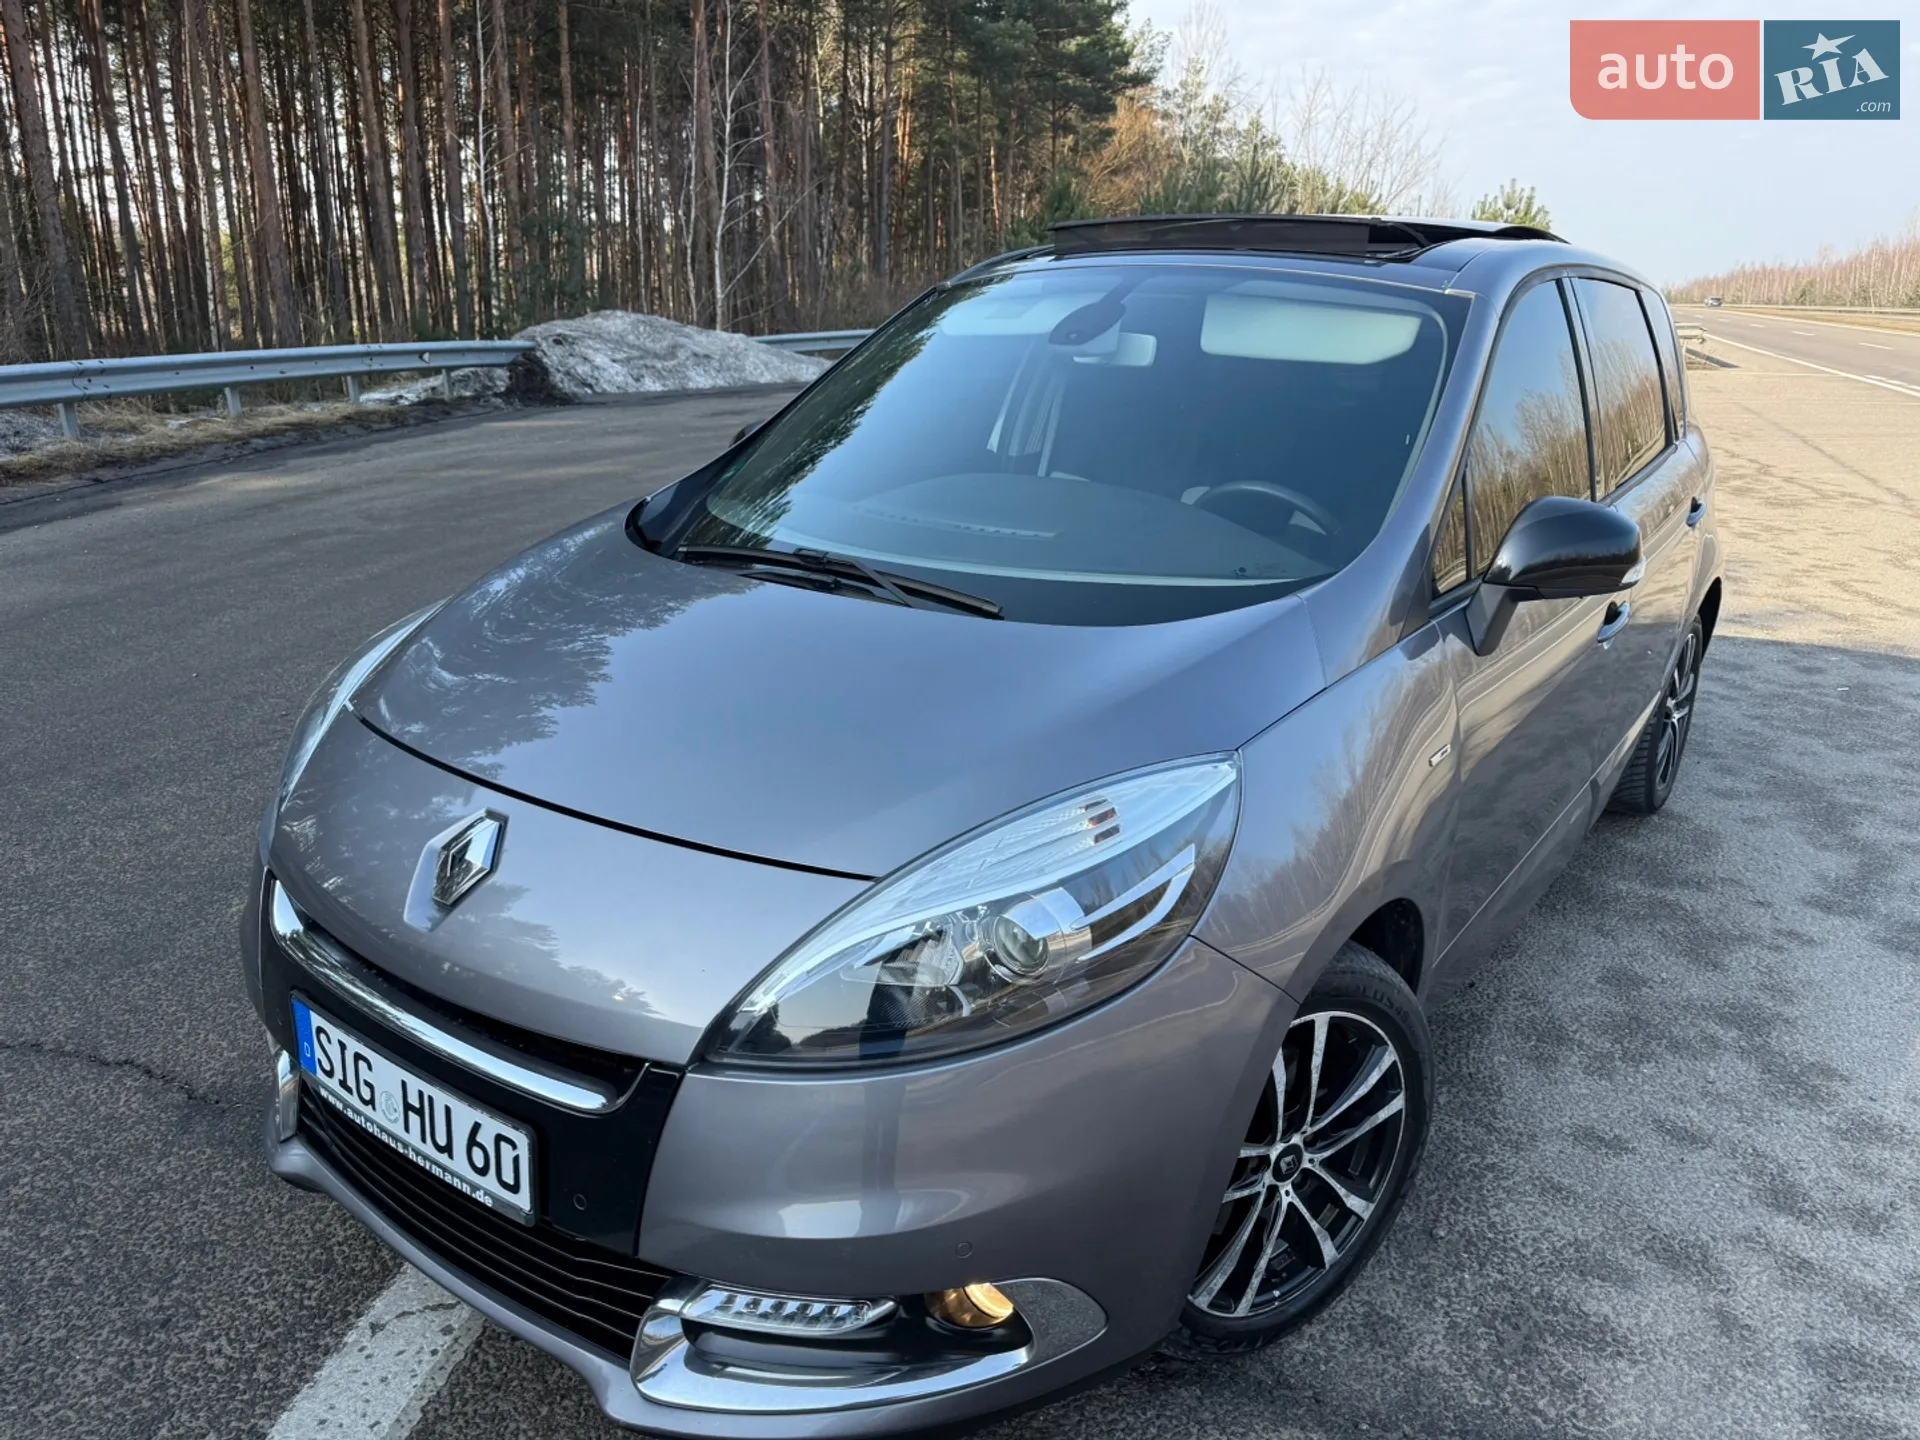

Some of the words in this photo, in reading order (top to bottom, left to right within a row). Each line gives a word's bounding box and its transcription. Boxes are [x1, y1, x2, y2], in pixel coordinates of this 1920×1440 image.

[303, 1041, 311, 1058] D
[315, 1025, 377, 1112] SIG
[401, 1079, 454, 1161] HU
[466, 1121, 521, 1195] 60
